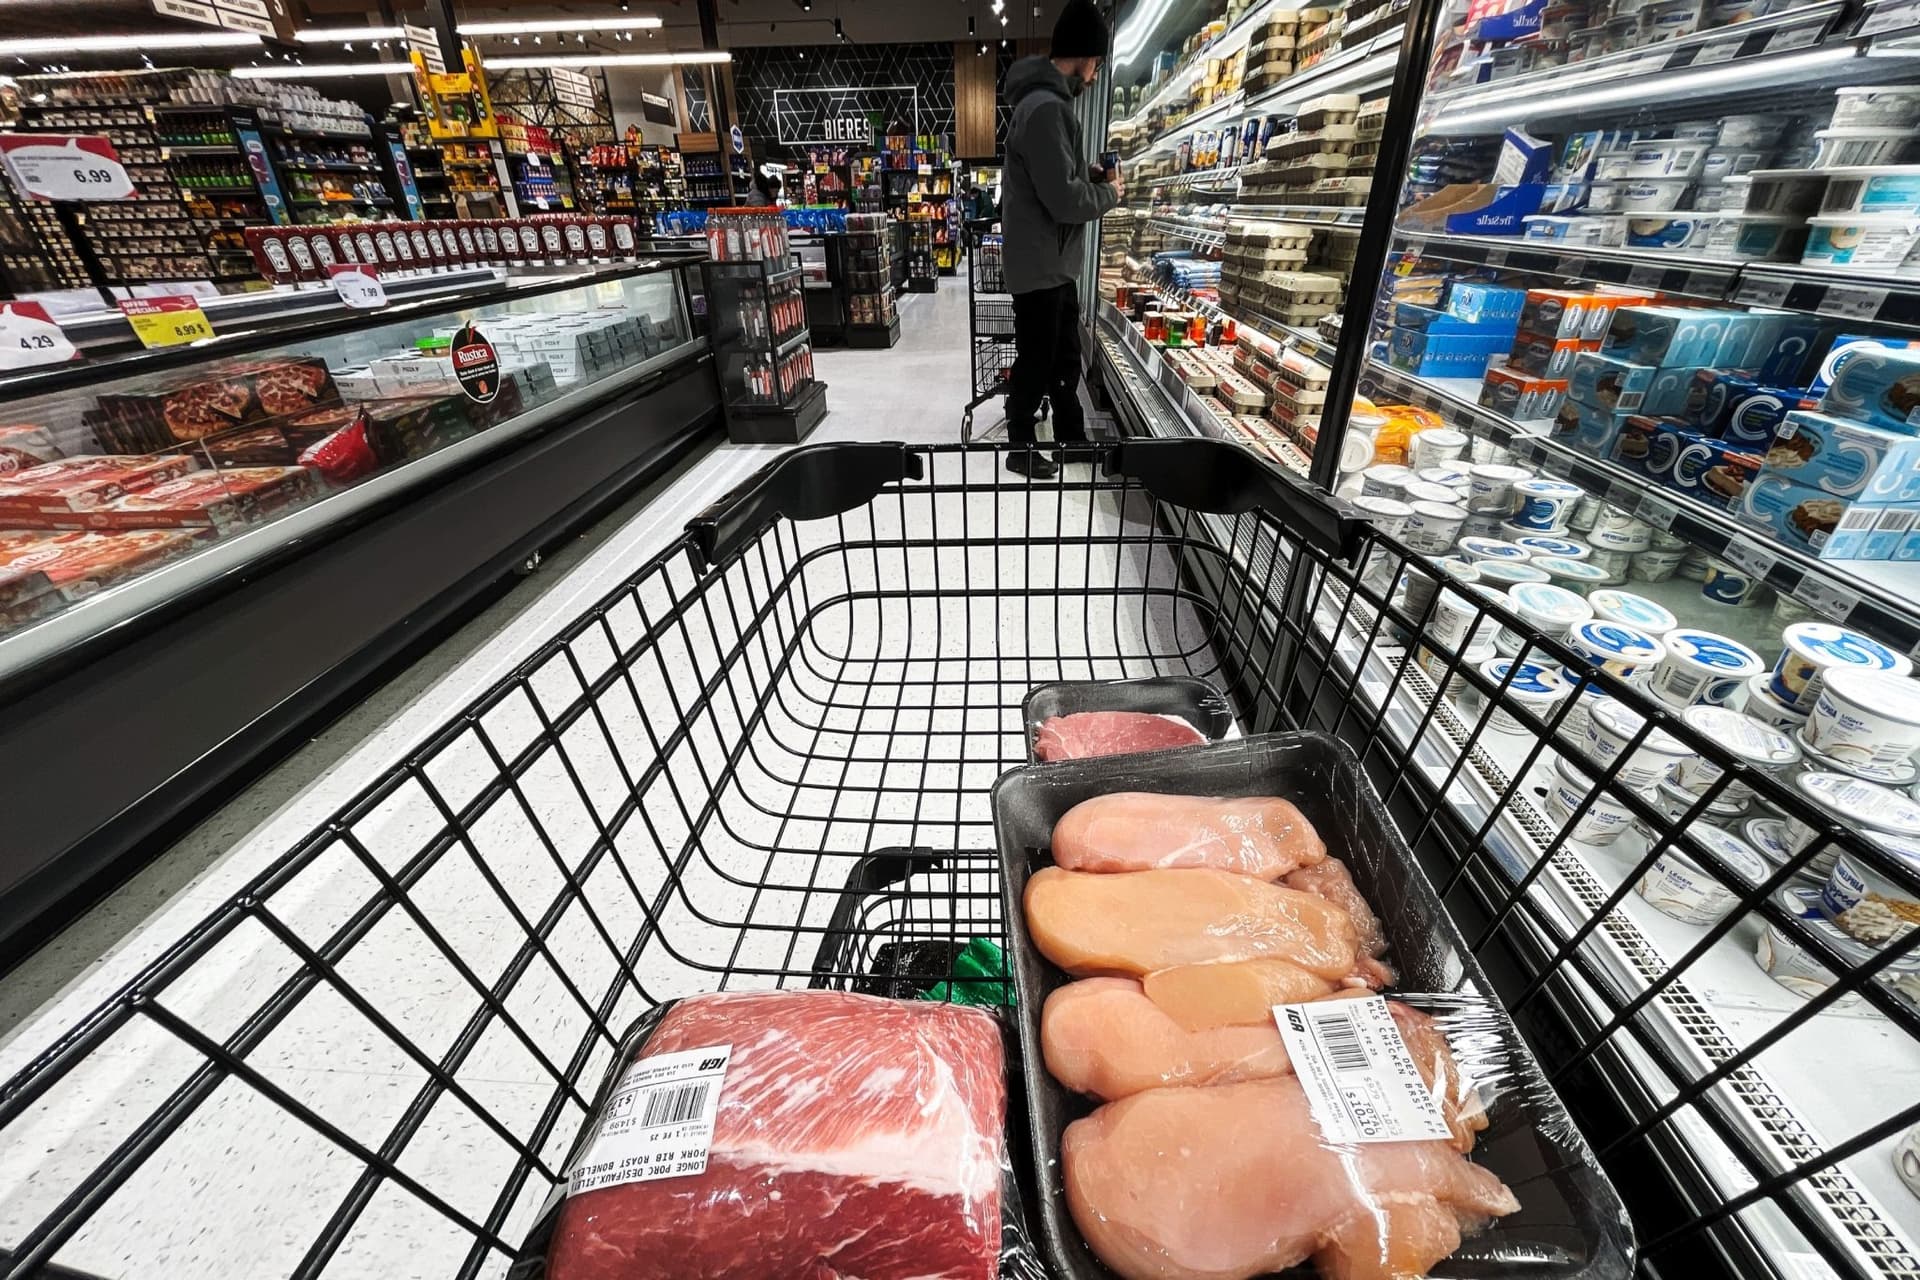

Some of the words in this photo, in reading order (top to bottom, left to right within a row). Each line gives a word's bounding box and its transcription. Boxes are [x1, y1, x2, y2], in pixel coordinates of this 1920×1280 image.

[73, 169, 112, 183] 6.99
[361, 287, 378, 297] 7.99
[175, 324, 196, 337] 8.99
[20, 335, 55, 350] 4.29
[458, 348, 488, 364] Rustica
[1285, 1007, 1305, 1032] IGA
[698, 1056, 727, 1071] IGA
[1366, 1001, 1380, 1020] BLS
[1379, 1027, 1406, 1075] CHICKEN
[1405, 1083, 1425, 1111] BRST
[1375, 999, 1391, 1021] POIT
[1388, 1027, 1404, 1052] POUL
[1402, 1057, 1417, 1076] DES
[1415, 1083, 1437, 1115] PAREE
[1346, 1091, 1376, 1136] $10.10
[1363, 1102, 1382, 1133] TOTAL
[656, 1152, 675, 1160] RIB
[681, 1148, 707, 1160] PORK
[620, 1155, 650, 1169] ROAST
[676, 1160, 706, 1171] LONGE
[572, 1161, 614, 1181] BONELESS
[647, 1164, 672, 1176] PORC
